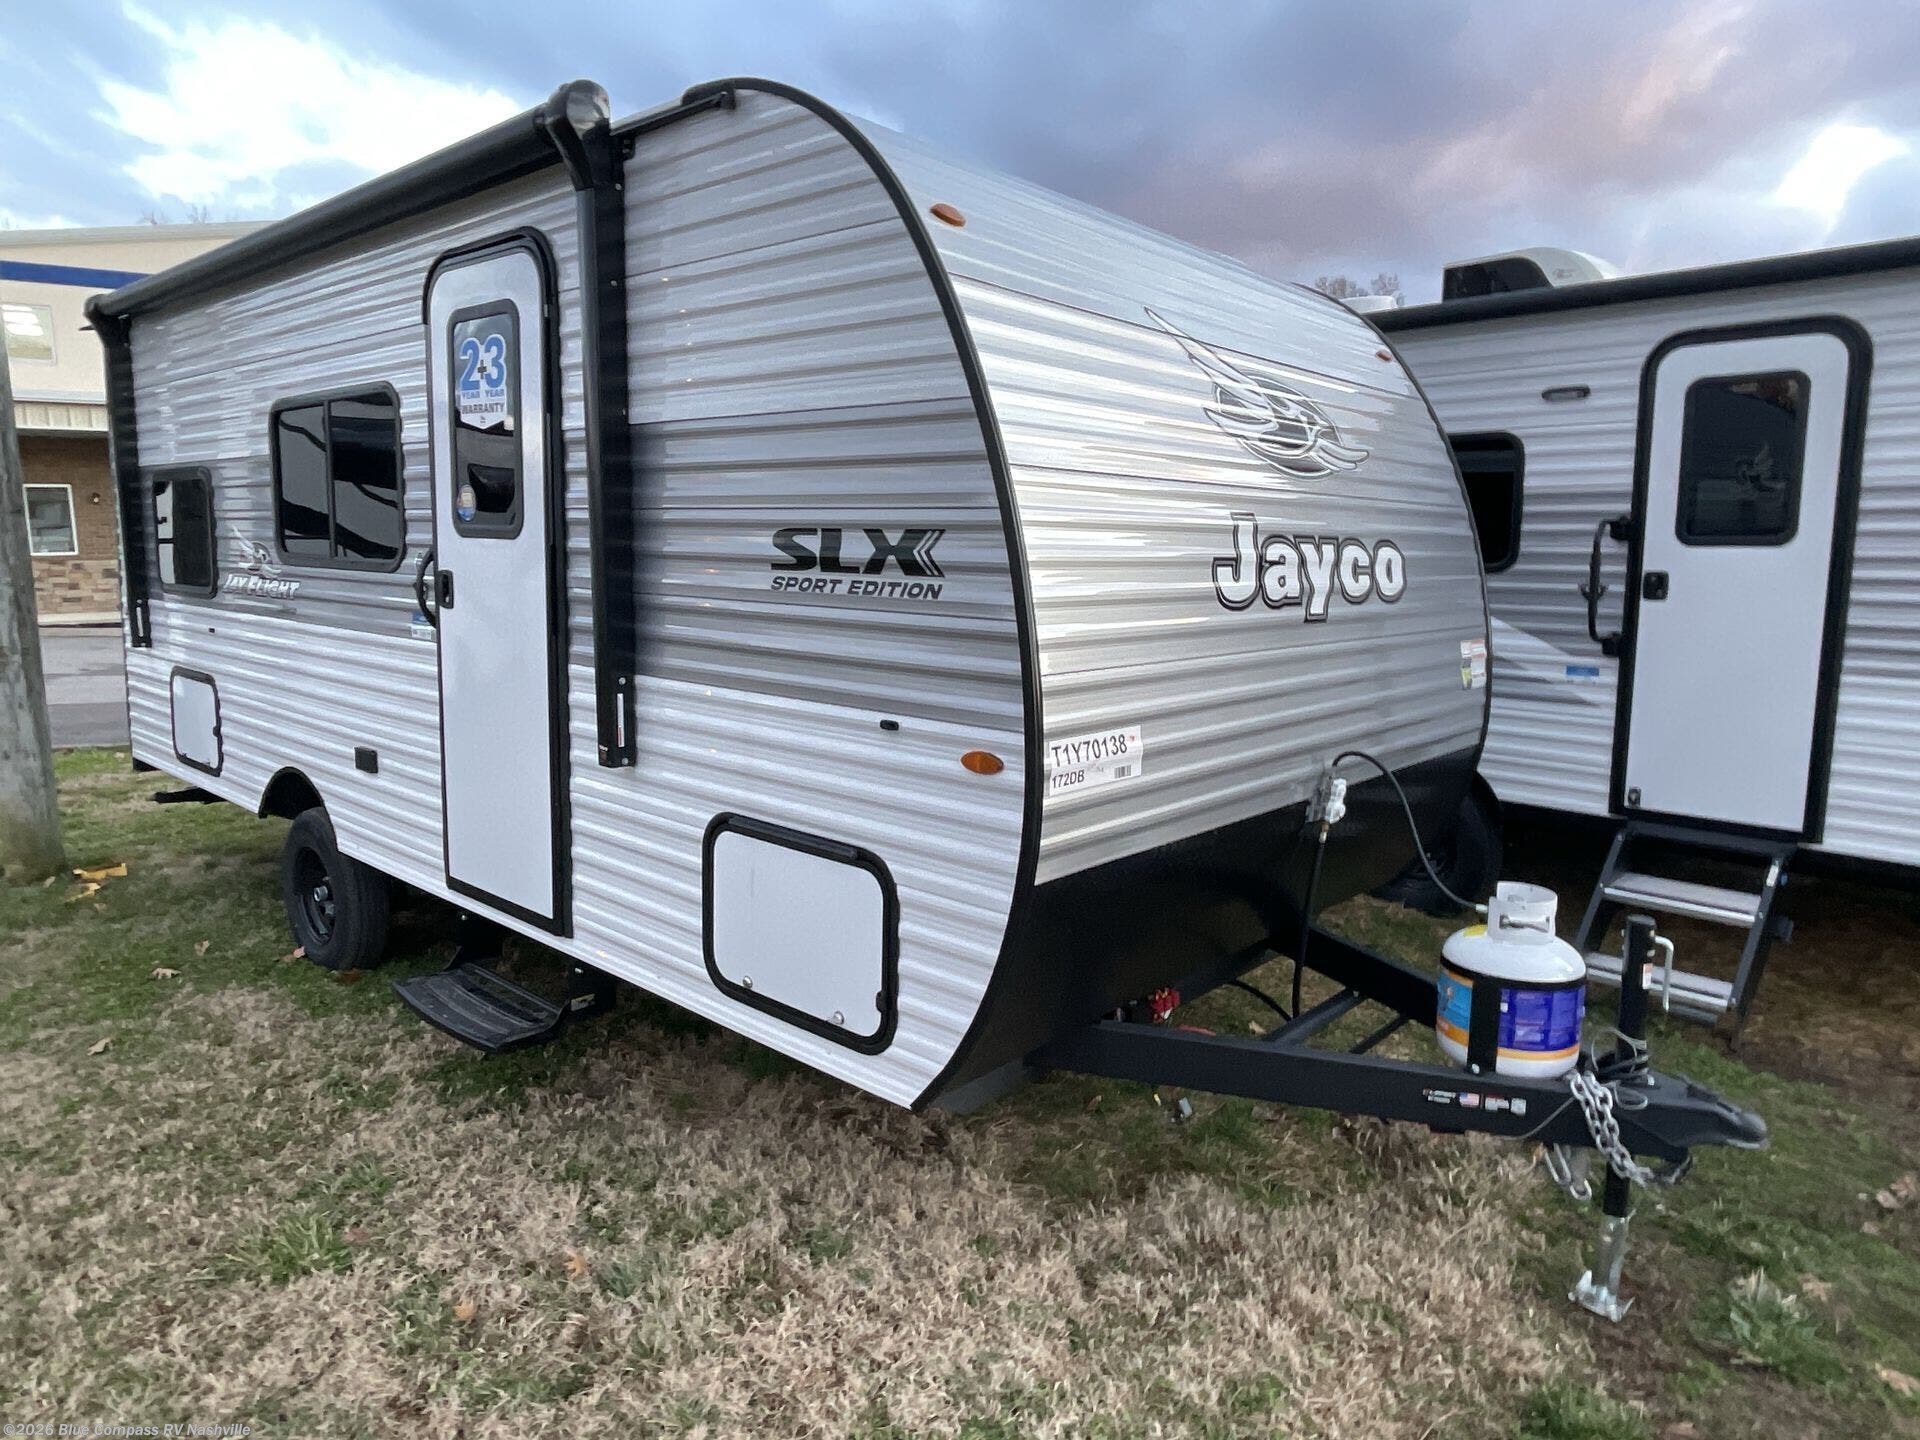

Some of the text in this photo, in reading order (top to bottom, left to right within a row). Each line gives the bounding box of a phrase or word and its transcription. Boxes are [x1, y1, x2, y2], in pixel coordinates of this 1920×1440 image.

[484, 389, 505, 398] YEAR
[461, 403, 505, 415] WARRANTY
[771, 527, 946, 578] SLX
[1212, 511, 1407, 624] Jayco
[771, 575, 943, 600] SPORT EDITION
[1051, 733, 1128, 767] T1Y70138
[1052, 769, 1085, 789] 172DB
